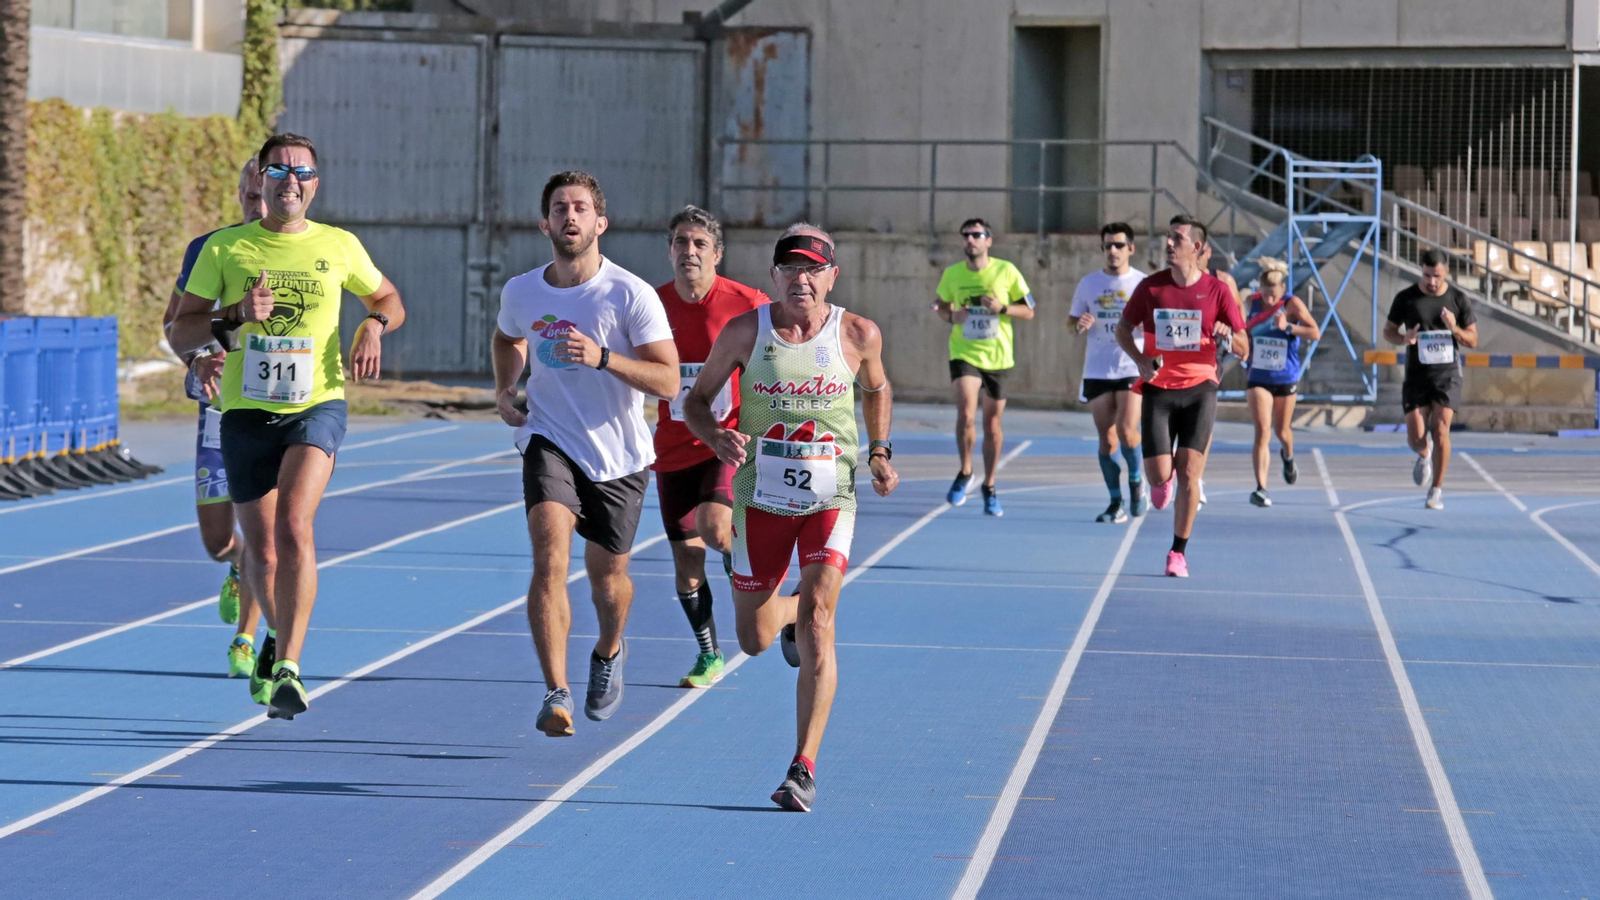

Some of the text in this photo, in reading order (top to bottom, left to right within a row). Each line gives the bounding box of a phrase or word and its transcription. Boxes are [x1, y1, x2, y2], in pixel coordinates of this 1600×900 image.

[243, 277, 324, 297] KIPTONITA
[1165, 325, 1190, 337] 241
[1260, 349, 1280, 359] 256
[258, 361, 296, 381] 311
[753, 374, 847, 395] maratón
[769, 400, 832, 409] JEREZ
[783, 468, 812, 491] 52
